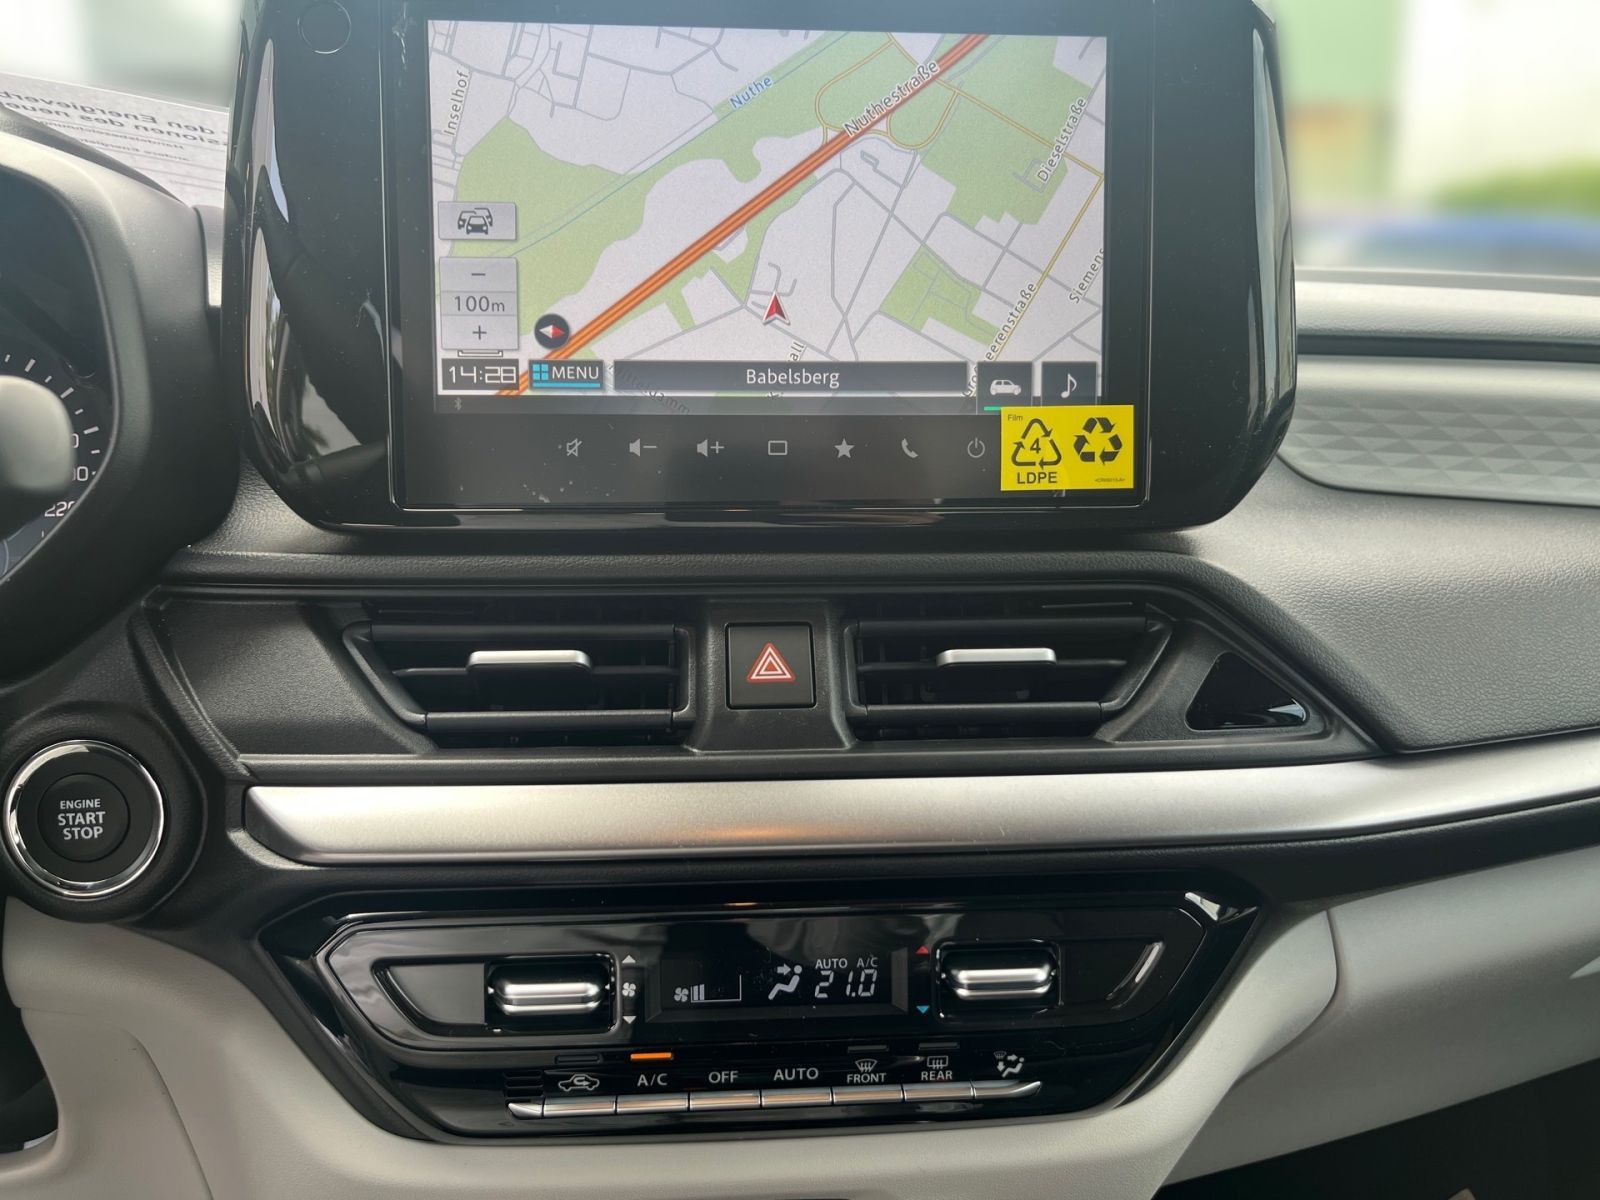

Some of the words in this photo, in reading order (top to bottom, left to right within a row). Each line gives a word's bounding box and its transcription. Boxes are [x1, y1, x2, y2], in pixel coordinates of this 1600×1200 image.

[729, 75, 773, 109] Nuthe
[845, 60, 940, 136] Nuthestraße
[443, 70, 471, 136] Inselhof
[1037, 97, 1087, 183] Dieselstraße
[453, 295, 506, 313] 100m
[449, 365, 517, 384] 14:28
[552, 366, 599, 380] MENU
[745, 368, 841, 389] Babelsberg
[1007, 413, 1024, 421] Film
[1030, 438, 1042, 453] 4
[1017, 472, 1058, 485] LDPE
[60, 798, 101, 809] ENGINE
[58, 811, 106, 826] START
[63, 826, 104, 840] STOP
[815, 957, 848, 969] AUTO
[856, 956, 879, 968] A/C
[814, 969, 879, 998] 21.0
[637, 1073, 668, 1087] A/C
[708, 1070, 739, 1084] OFF
[773, 1067, 819, 1081] AUTO
[846, 1073, 887, 1084] FRONT
[920, 1070, 953, 1081] REAR
